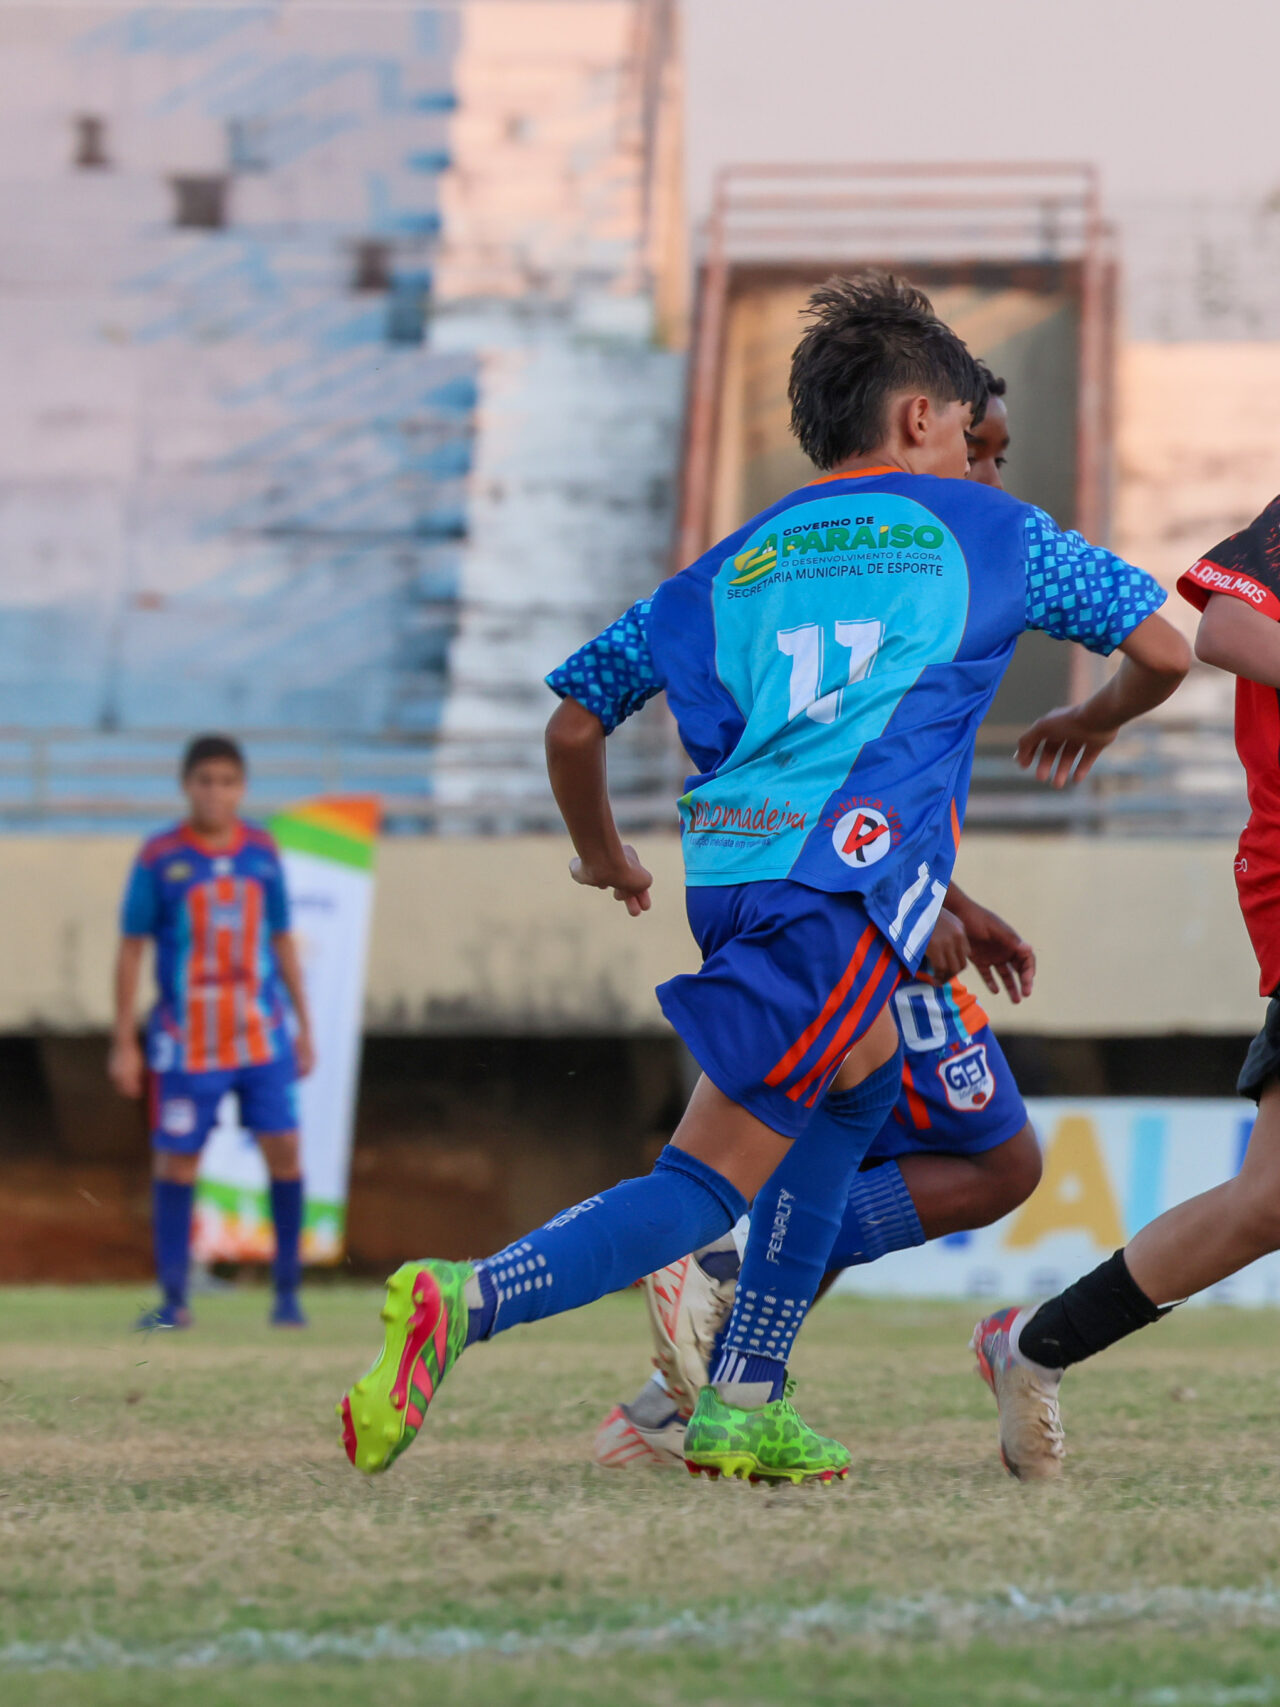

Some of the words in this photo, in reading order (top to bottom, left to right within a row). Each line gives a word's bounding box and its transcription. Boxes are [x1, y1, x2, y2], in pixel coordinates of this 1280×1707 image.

[783, 518, 851, 537] GOVERNO
[856, 516, 875, 526] DE
[781, 560, 790, 568] O
[792, 551, 893, 567] DESENVOLVIMENTO
[905, 552, 943, 562] AGORA
[727, 571, 793, 600] SECRETARIA
[795, 565, 864, 580] MUNICIPAL
[867, 562, 884, 574] DE
[887, 562, 944, 577] ESPORTE
[944, 1047, 987, 1091] GET
[765, 1187, 797, 1267] PENALTY
